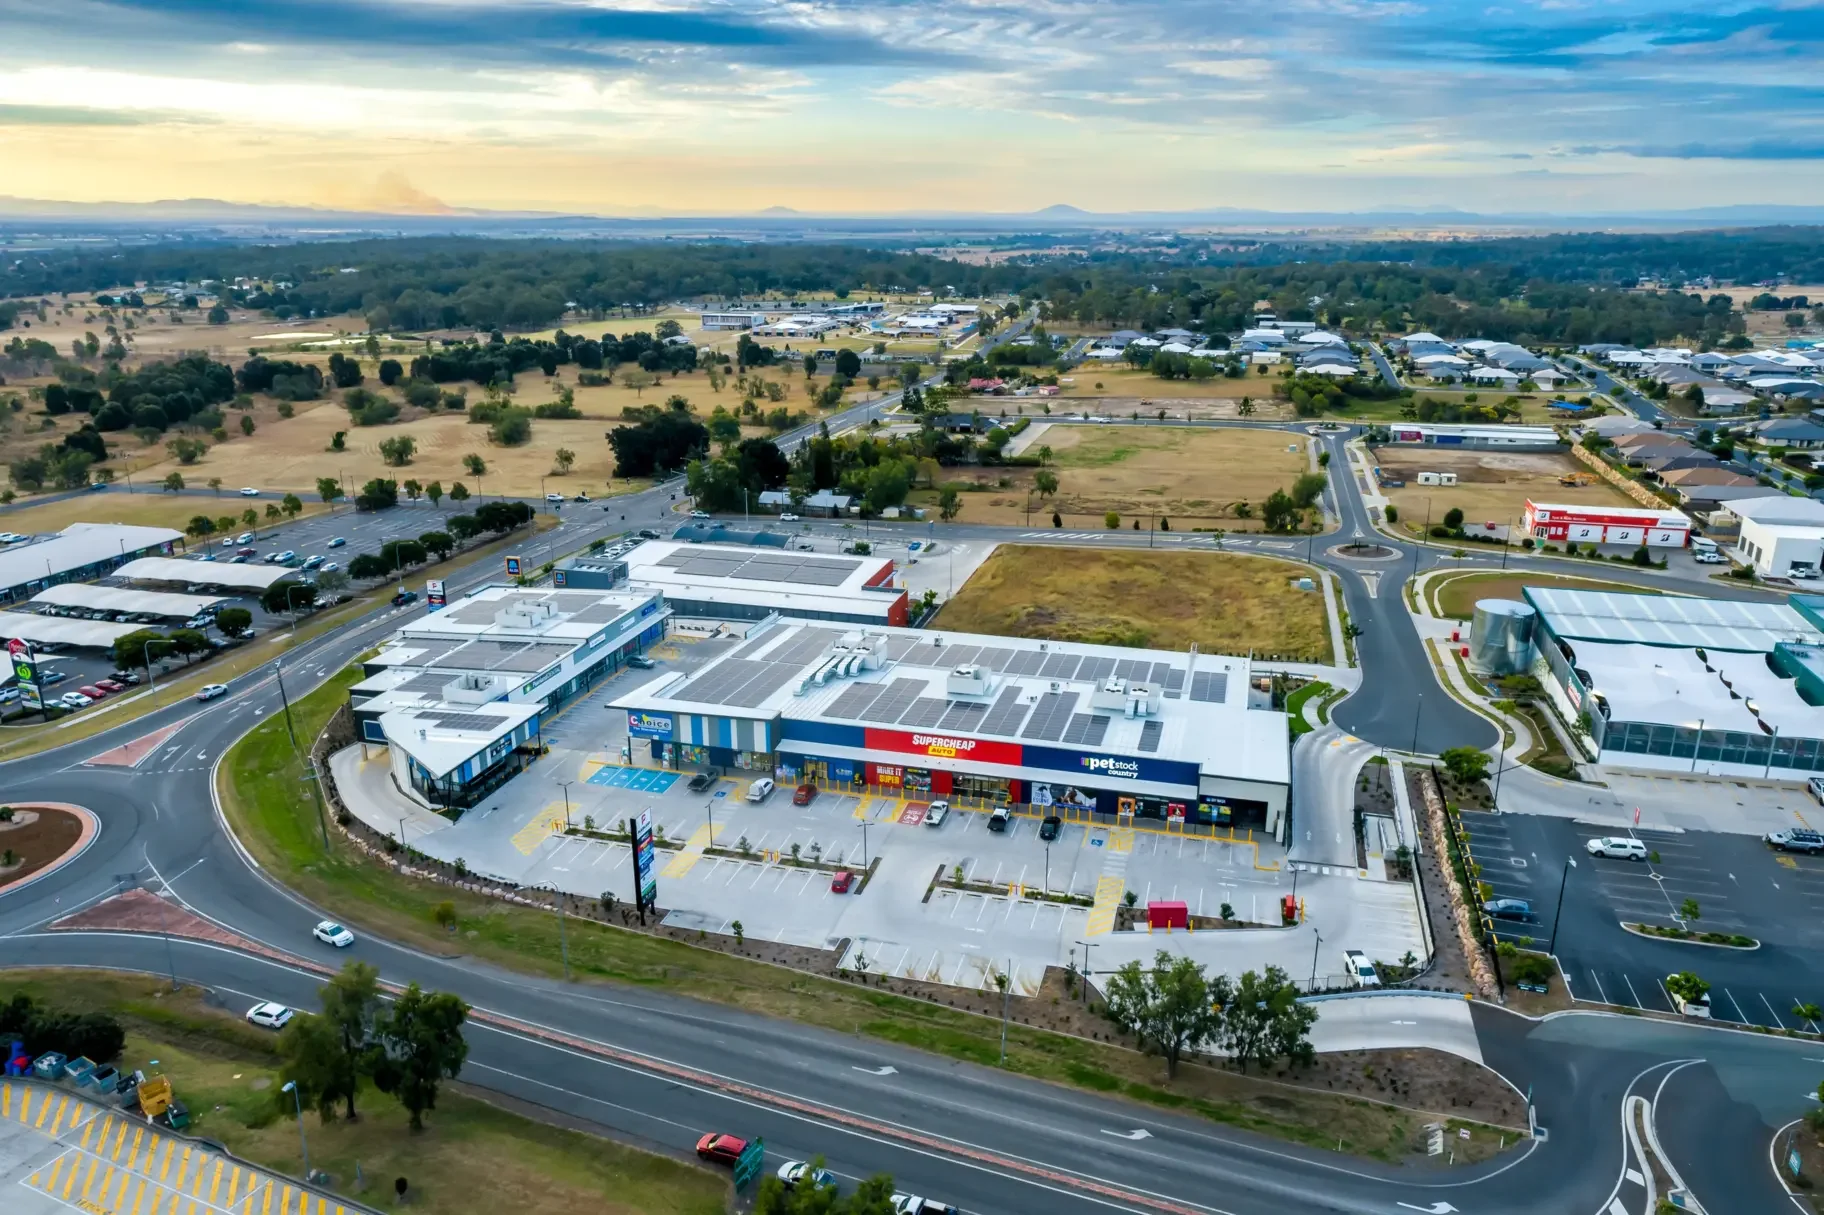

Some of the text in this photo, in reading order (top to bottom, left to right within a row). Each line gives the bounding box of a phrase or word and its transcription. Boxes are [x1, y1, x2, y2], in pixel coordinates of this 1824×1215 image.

[630, 715, 670, 728] Choice
[912, 734, 976, 751] SUPERCHEAP
[876, 765, 895, 776] MAKE
[895, 768, 902, 776] IT
[1107, 769, 1139, 779] country
[879, 774, 900, 784] SUPER
